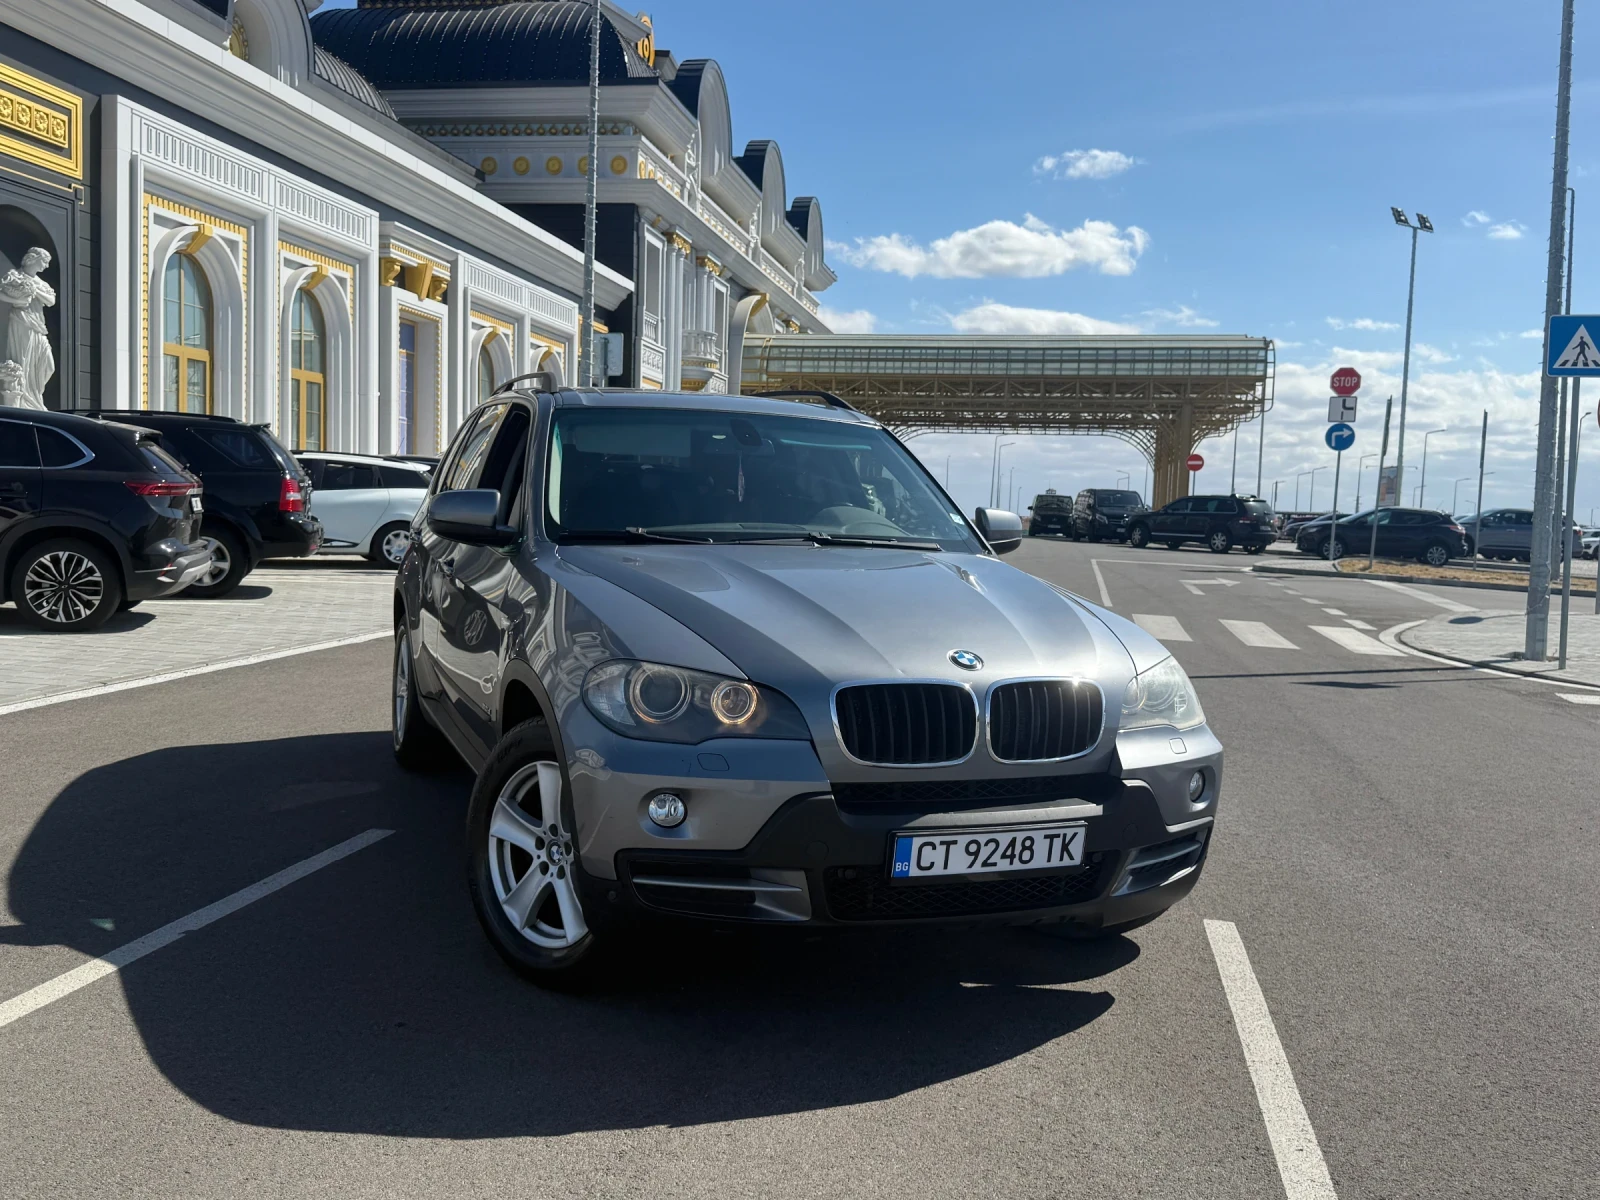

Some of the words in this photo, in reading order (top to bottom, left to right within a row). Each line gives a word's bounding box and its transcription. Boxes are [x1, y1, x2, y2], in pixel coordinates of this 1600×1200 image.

[1333, 376, 1357, 387] STOP
[916, 840, 958, 871] CT
[964, 835, 1035, 869] 9248
[1043, 831, 1079, 863] TK
[895, 862, 909, 872] BG
